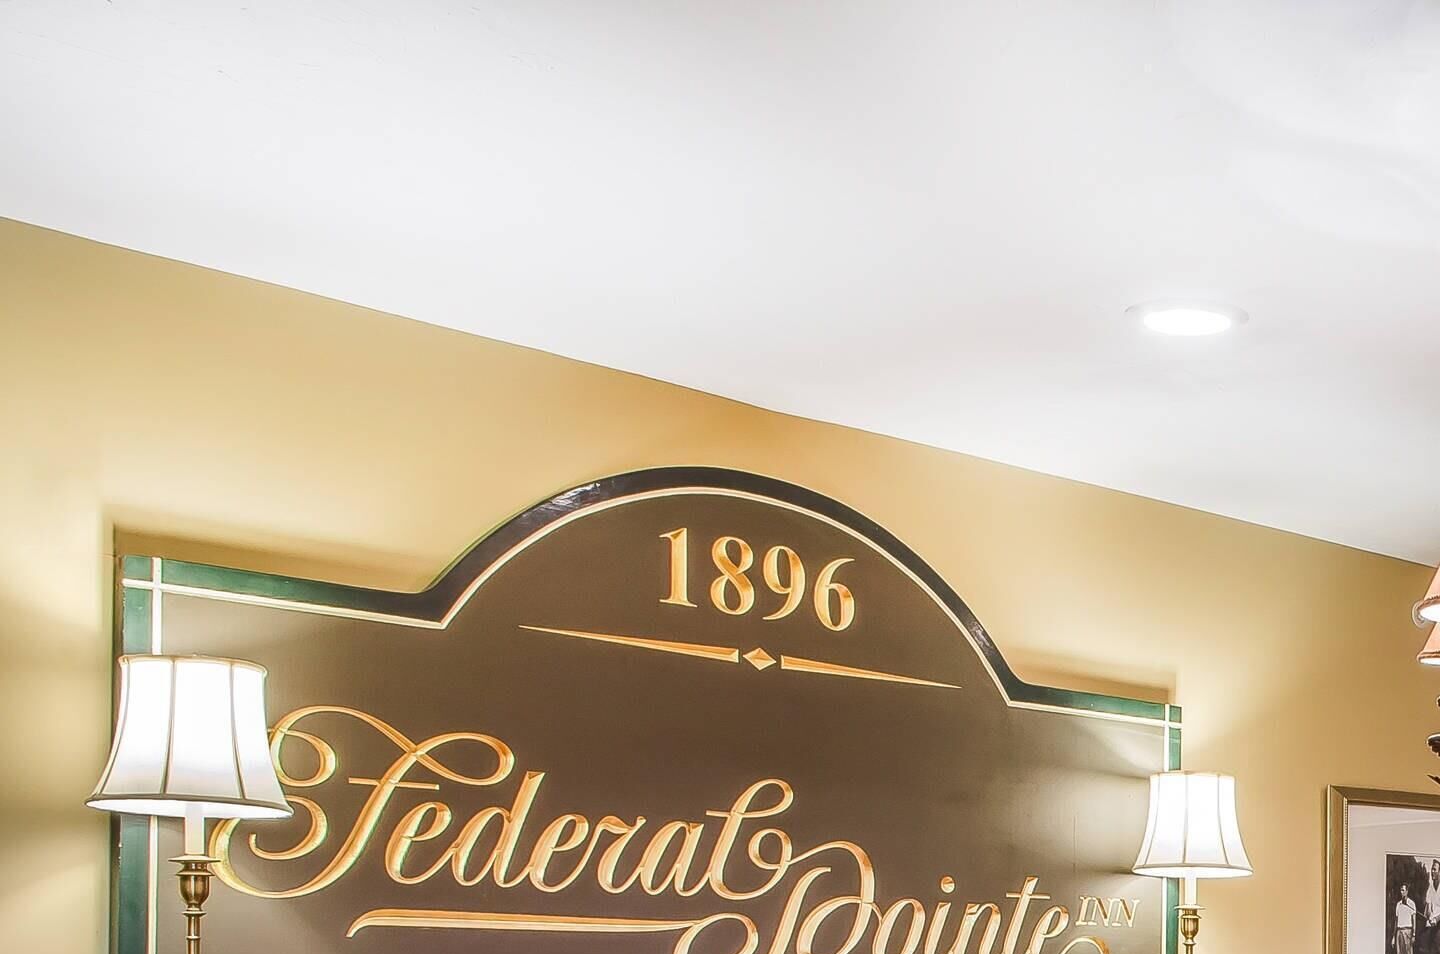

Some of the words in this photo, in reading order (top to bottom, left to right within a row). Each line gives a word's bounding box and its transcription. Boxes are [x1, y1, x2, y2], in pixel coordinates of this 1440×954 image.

[659, 527, 856, 632] 1896
[208, 705, 795, 900] Federal
[1075, 895, 1140, 928] INN
